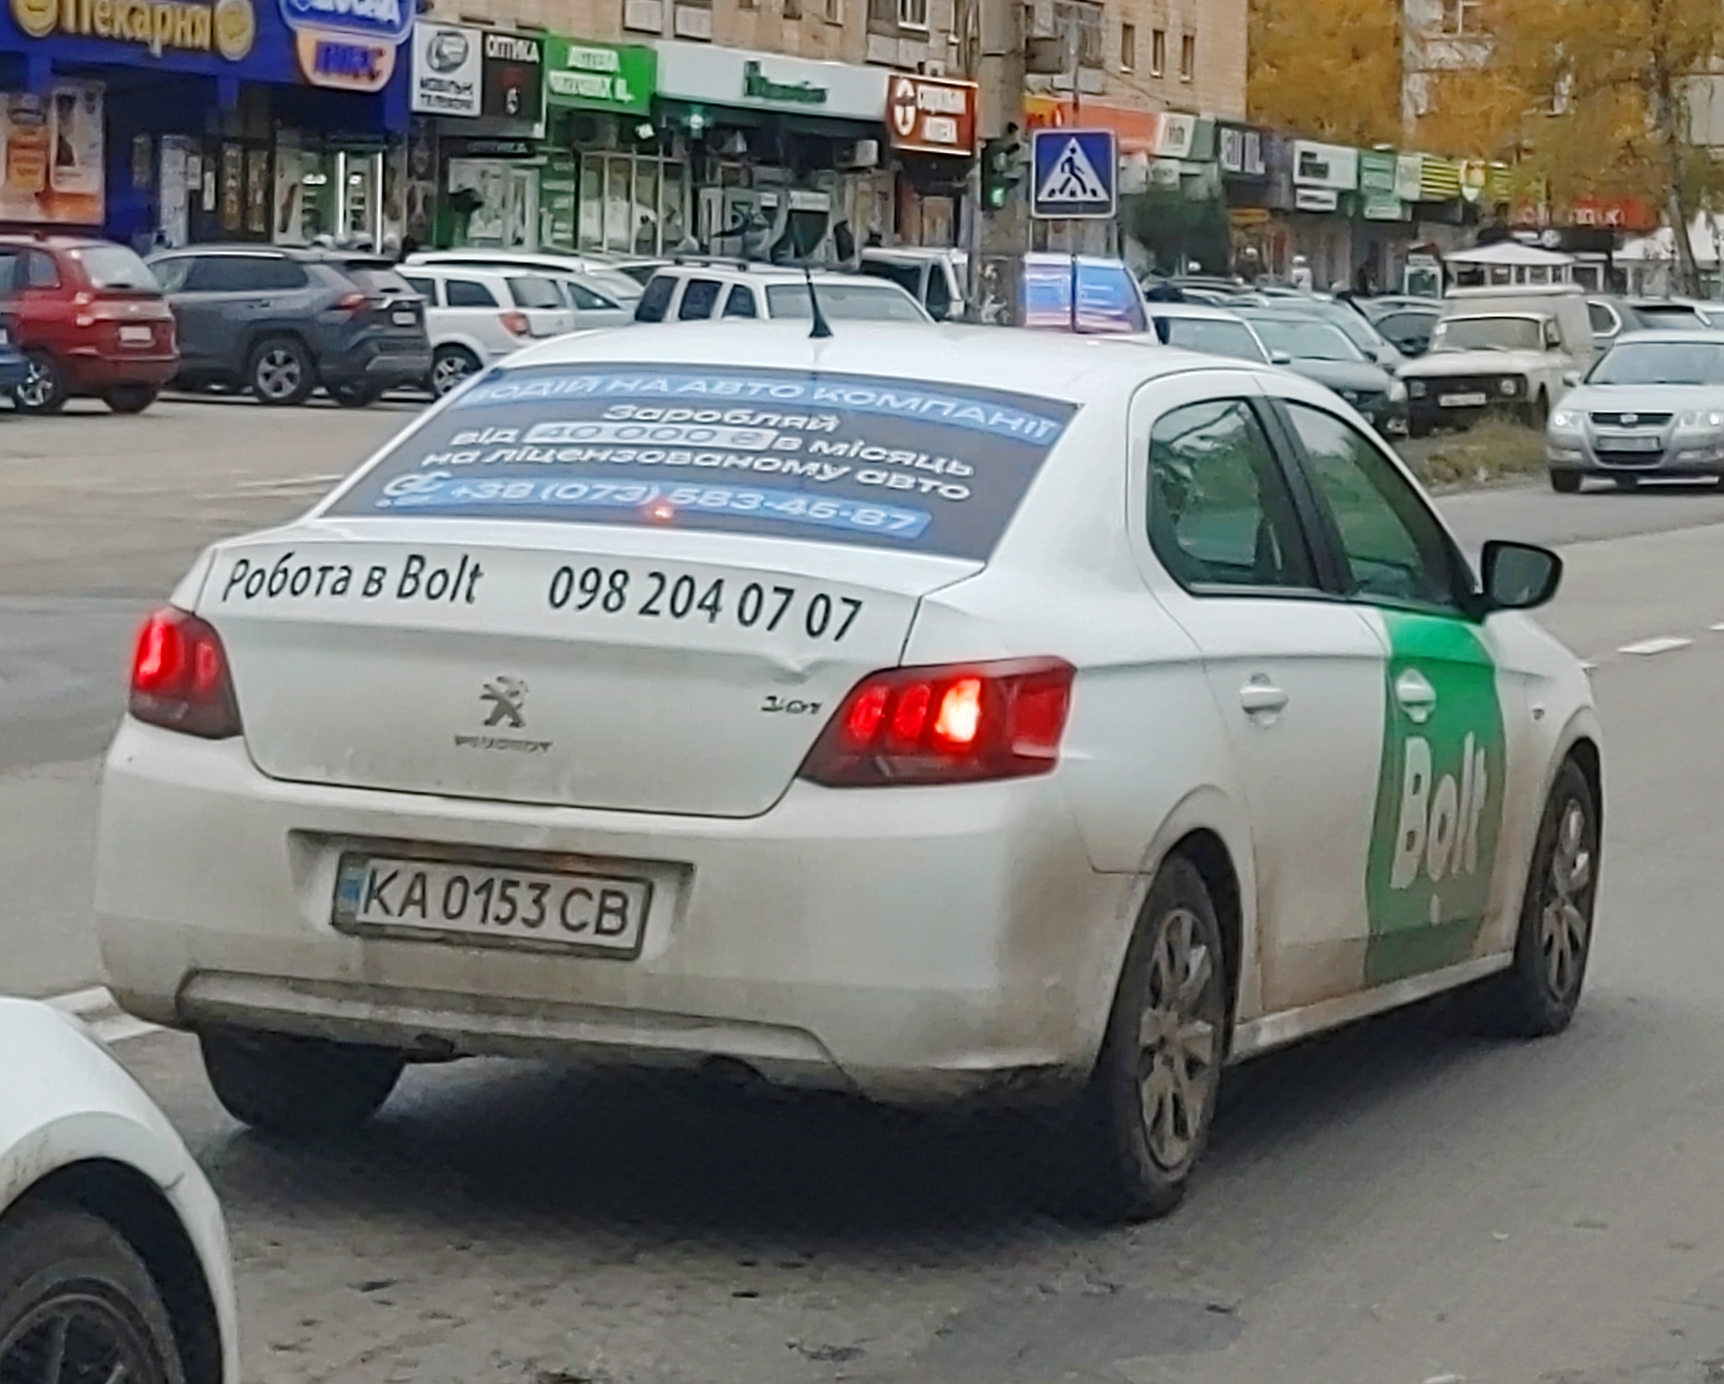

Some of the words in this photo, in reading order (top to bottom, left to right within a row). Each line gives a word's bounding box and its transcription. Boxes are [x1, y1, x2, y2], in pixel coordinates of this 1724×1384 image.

[485, 34, 540, 64] ОПТИКА
[603, 404, 841, 432] Заробляй
[606, 378, 669, 393] НА
[676, 379, 804, 398] АВТО
[813, 386, 1057, 439] КОМПАНІЇ
[421, 450, 483, 466] на
[484, 447, 851, 482] ліцензованому
[855, 469, 971, 501] авто
[450, 426, 521, 445] від
[614, 425, 717, 443] 000
[771, 436, 803, 451] в
[808, 439, 975, 477] місяць
[451, 482, 535, 499] +38
[540, 483, 661, 505] (073)
[221, 551, 353, 602] Робота
[362, 565, 387, 597] в
[396, 553, 485, 604] Bolt
[548, 565, 630, 612] 098
[638, 570, 725, 624] 204
[736, 581, 796, 631] 07
[804, 592, 864, 642] 07
[1390, 730, 1487, 889] Bolt
[441, 874, 551, 929] 0153
